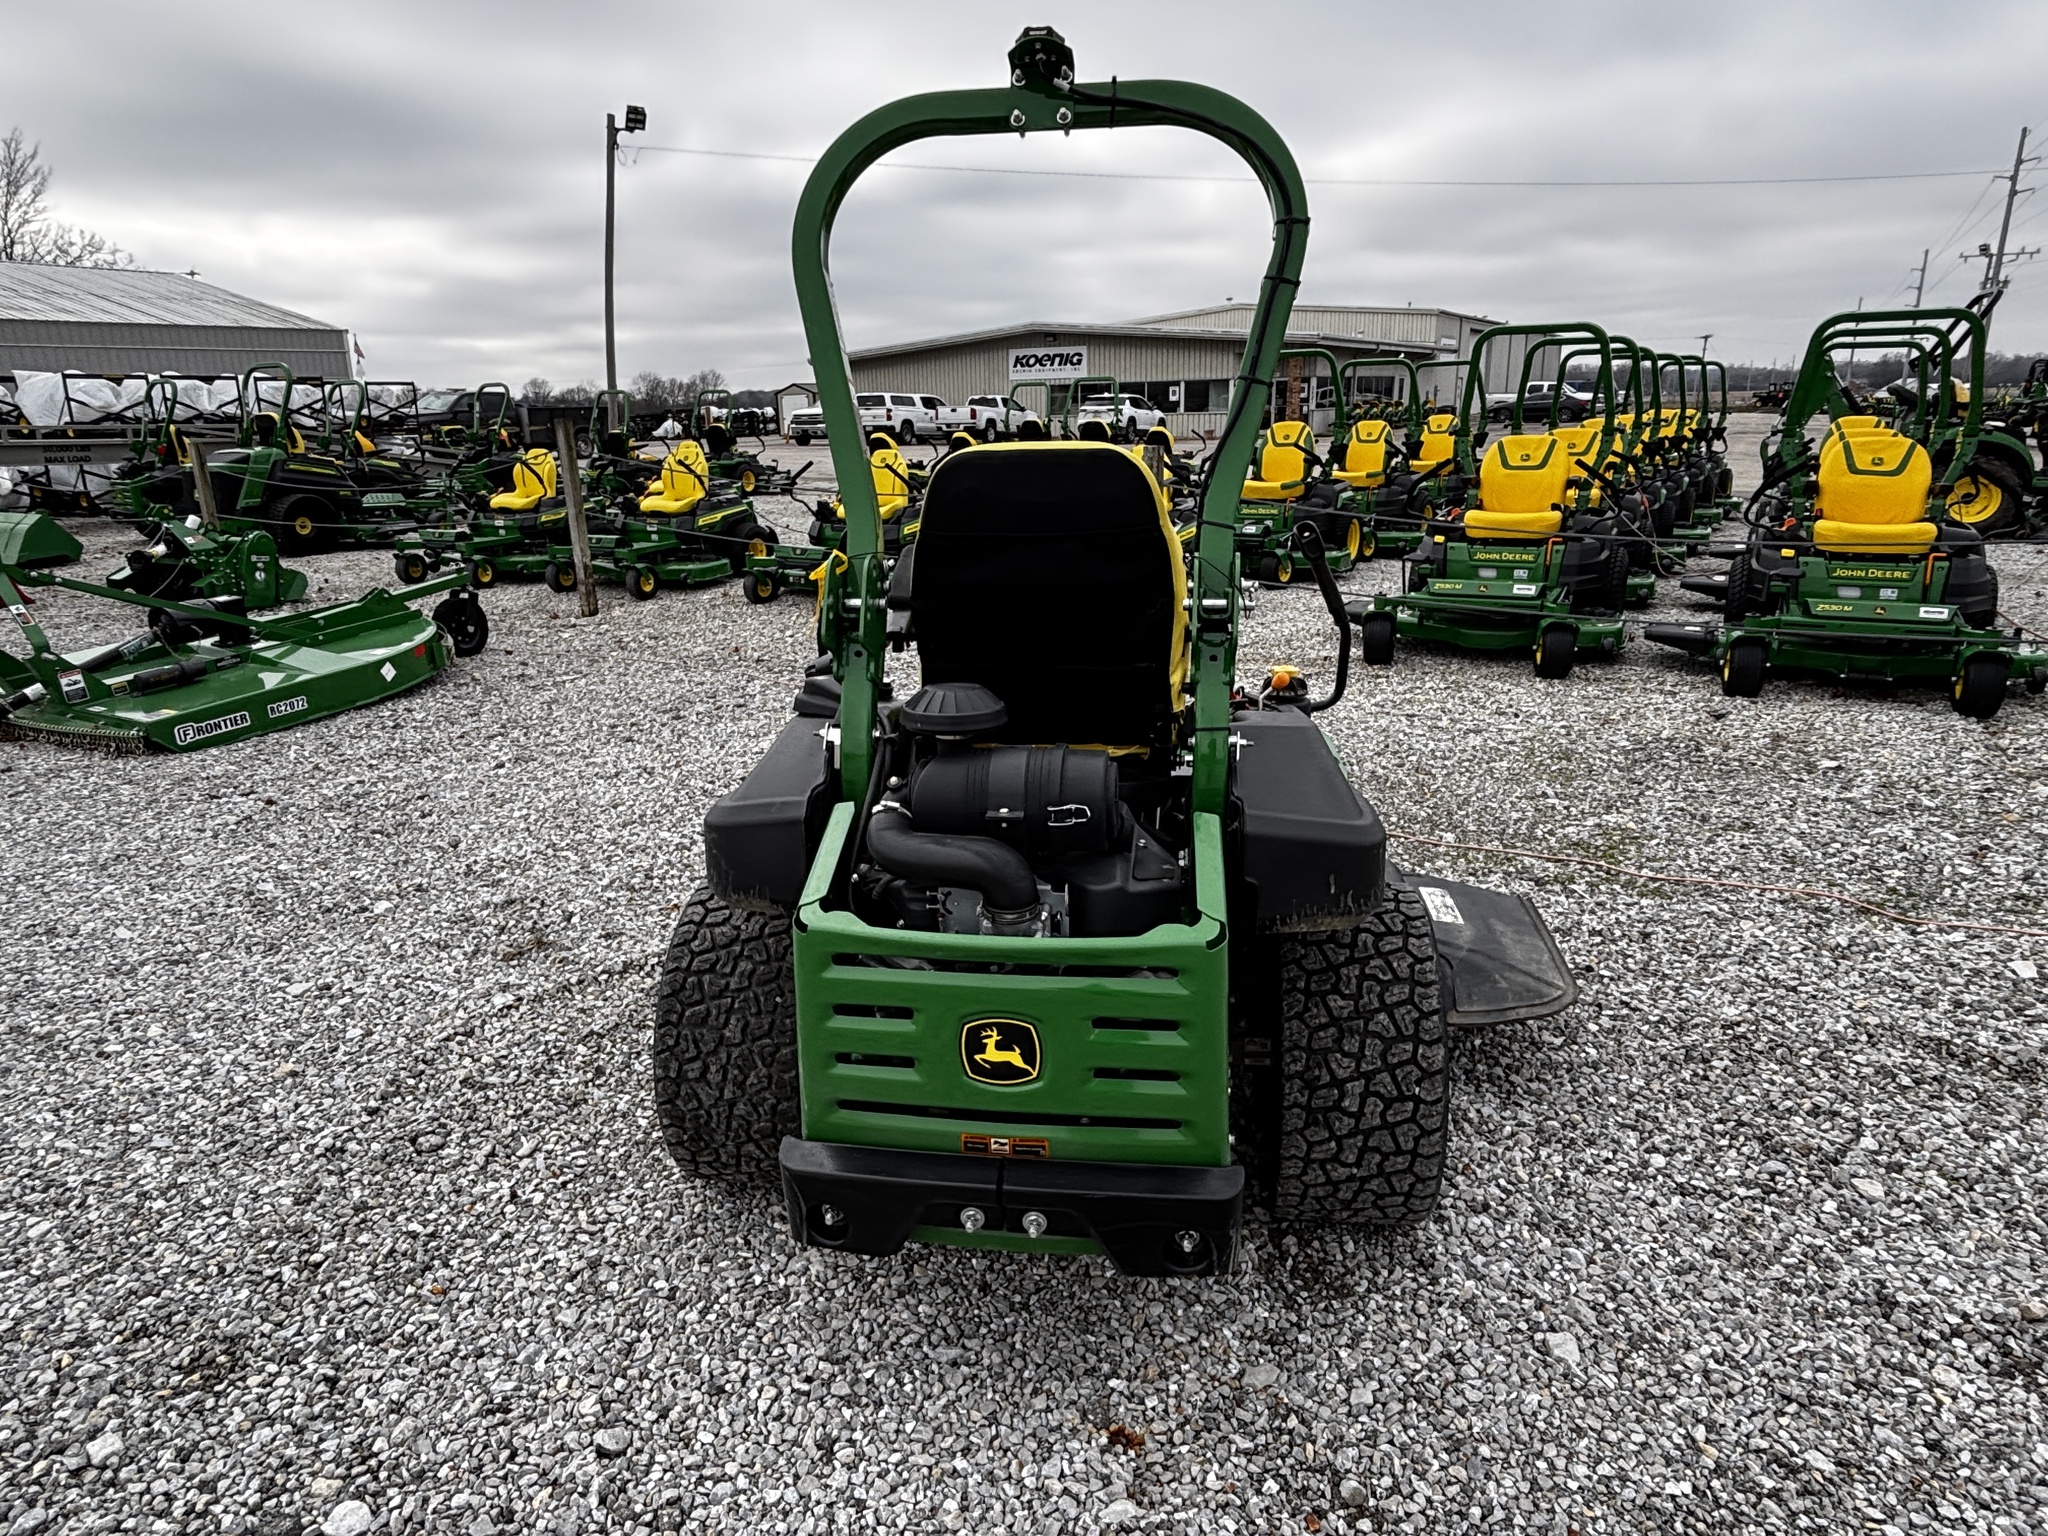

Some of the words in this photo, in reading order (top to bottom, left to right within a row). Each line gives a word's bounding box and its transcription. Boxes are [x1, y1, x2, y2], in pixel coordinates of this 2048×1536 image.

[44, 455, 66, 463] MAX
[67, 455, 91, 463] LOAD
[1473, 552, 1500, 560] JOHN
[1502, 552, 1536, 561] DEERE
[1832, 568, 1863, 578] JOHN
[1867, 568, 1911, 579] DEERE
[269, 697, 307, 717] RC2072
[177, 713, 249, 743] FRONTIER
